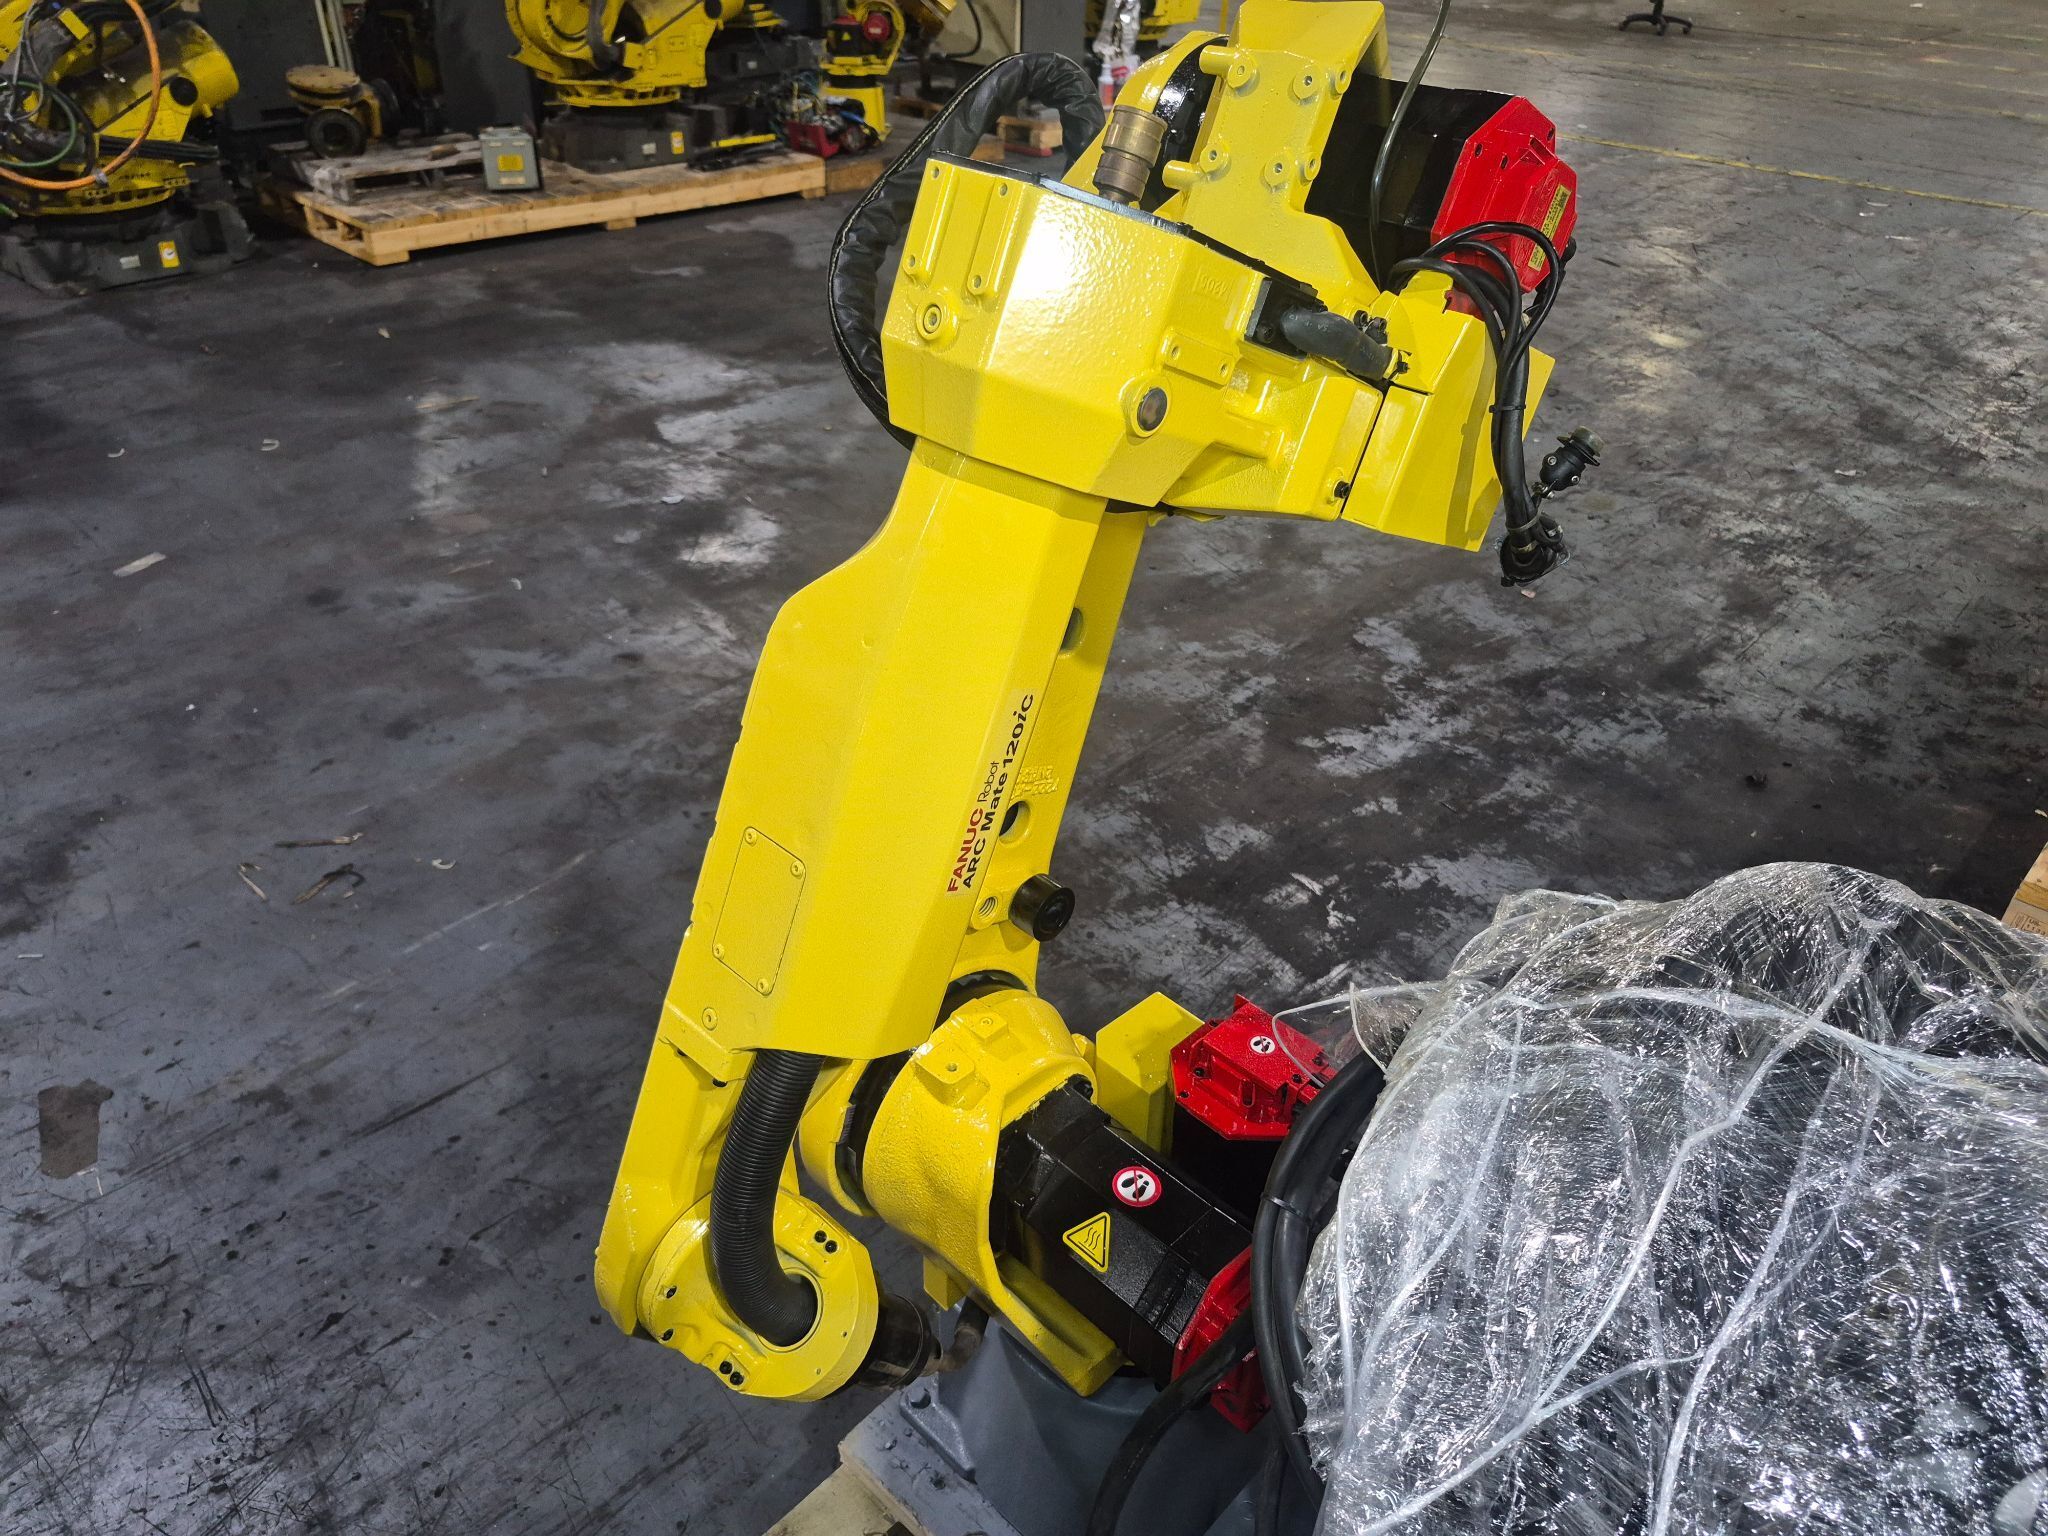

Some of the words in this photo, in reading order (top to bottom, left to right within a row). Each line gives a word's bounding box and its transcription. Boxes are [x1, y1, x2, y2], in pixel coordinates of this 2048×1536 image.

[947, 808, 983, 892] FANUC
[977, 761, 999, 803] Robot
[963, 837, 986, 889] ARC
[981, 773, 1008, 831] Mate
[1003, 694, 1033, 768] 120iC
